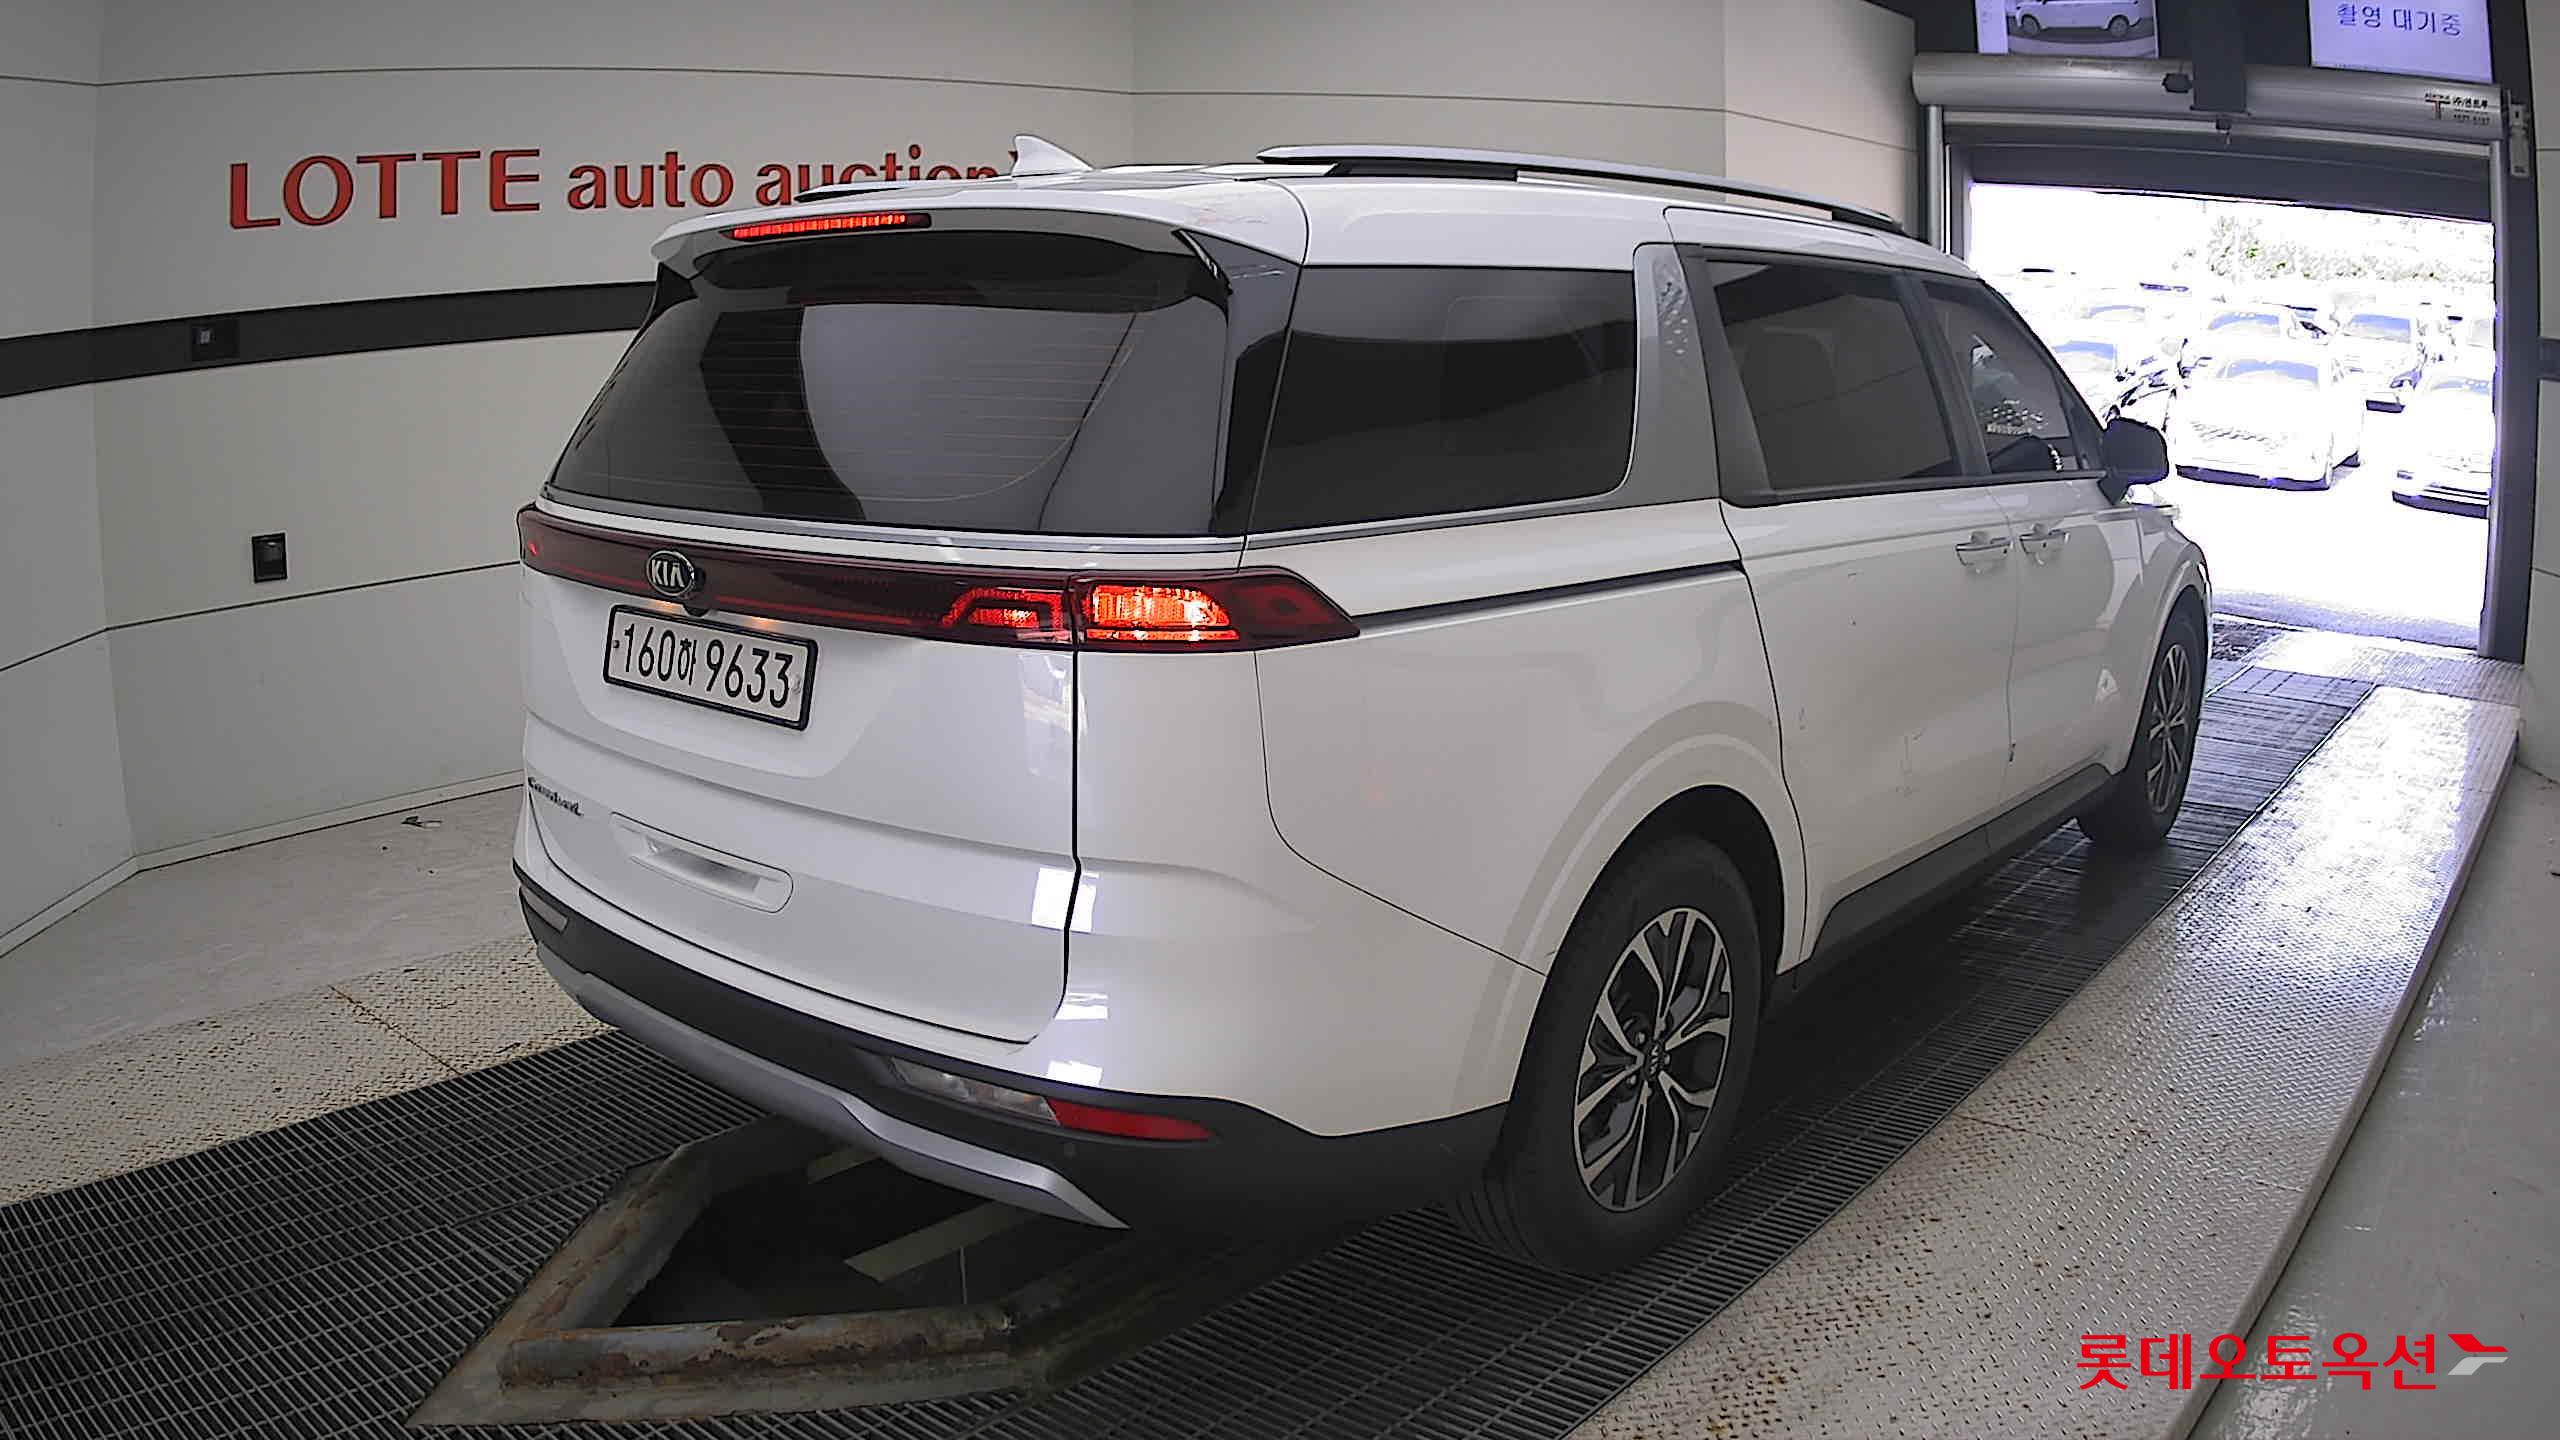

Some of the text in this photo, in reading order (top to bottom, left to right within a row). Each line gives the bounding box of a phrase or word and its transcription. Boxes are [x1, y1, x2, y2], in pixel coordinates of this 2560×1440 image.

[2338, 3, 2461, 37] 촬영 대기중
[229, 148, 540, 230] LOTTE
[567, 150, 734, 210] auto
[651, 558, 685, 588] KIA
[624, 623, 793, 708] 160하 9633
